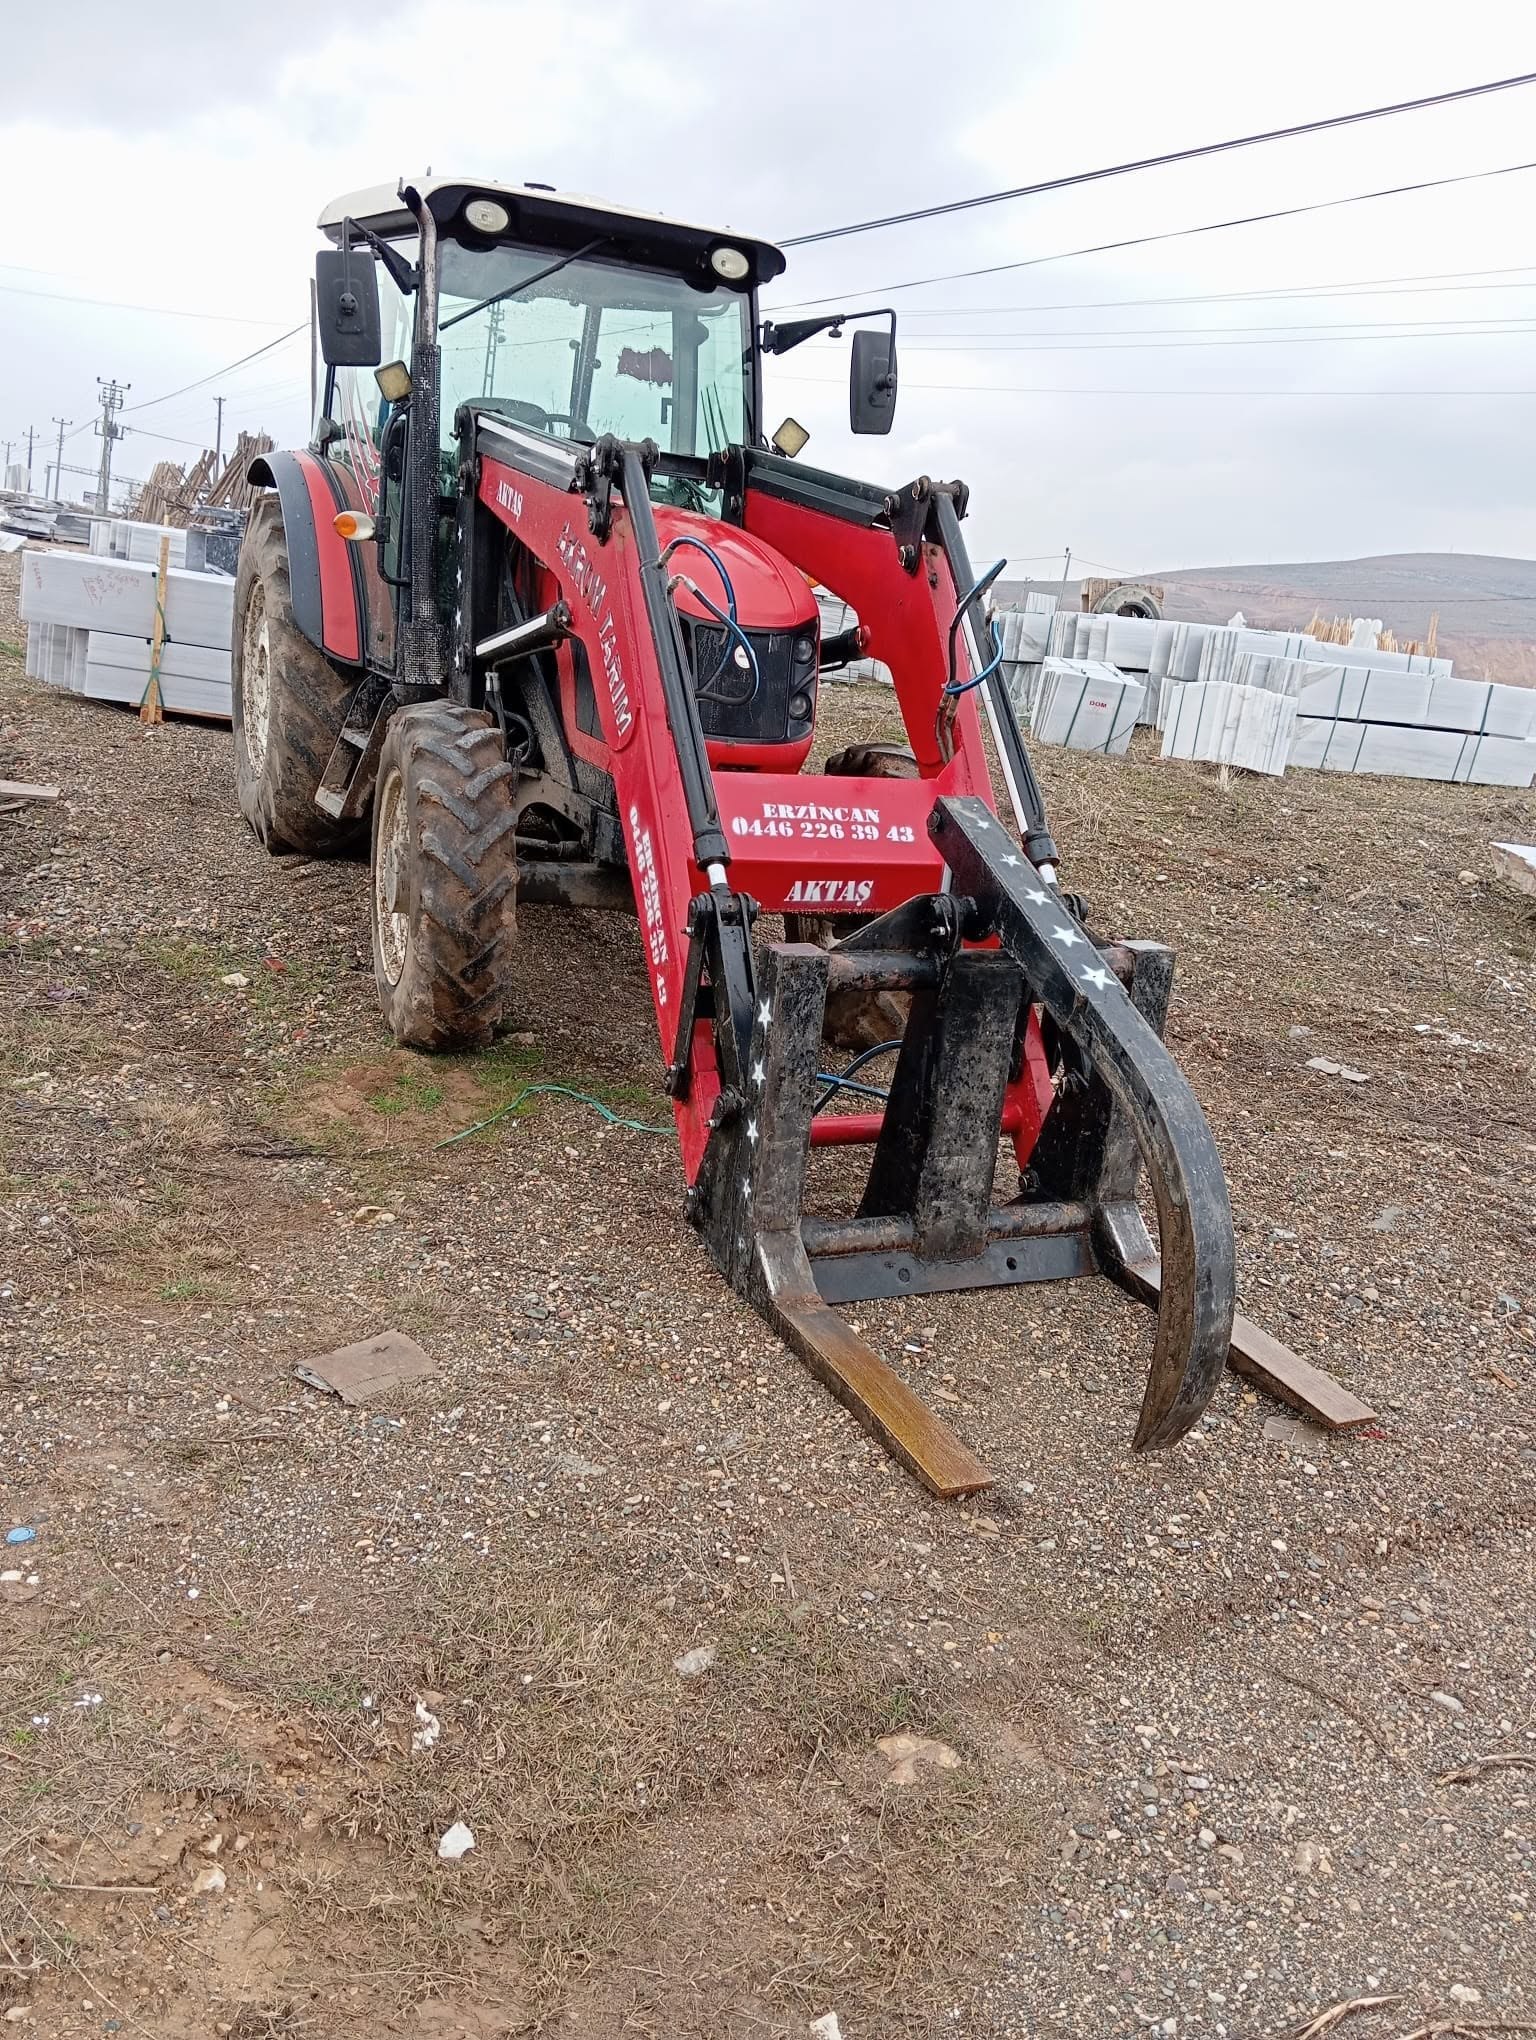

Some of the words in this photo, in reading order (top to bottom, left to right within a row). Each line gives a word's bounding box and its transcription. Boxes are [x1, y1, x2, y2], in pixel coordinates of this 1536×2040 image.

[496, 480, 524, 522] AKTAŞ
[598, 608, 633, 737] TARIM
[731, 816, 794, 837] 0446
[800, 822, 845, 839] 226
[851, 825, 880, 841] 39
[886, 826, 915, 842] 43
[762, 802, 880, 823] ERZİNCAN
[630, 806, 646, 873] 0446
[784, 880, 874, 905] AKTAŞ
